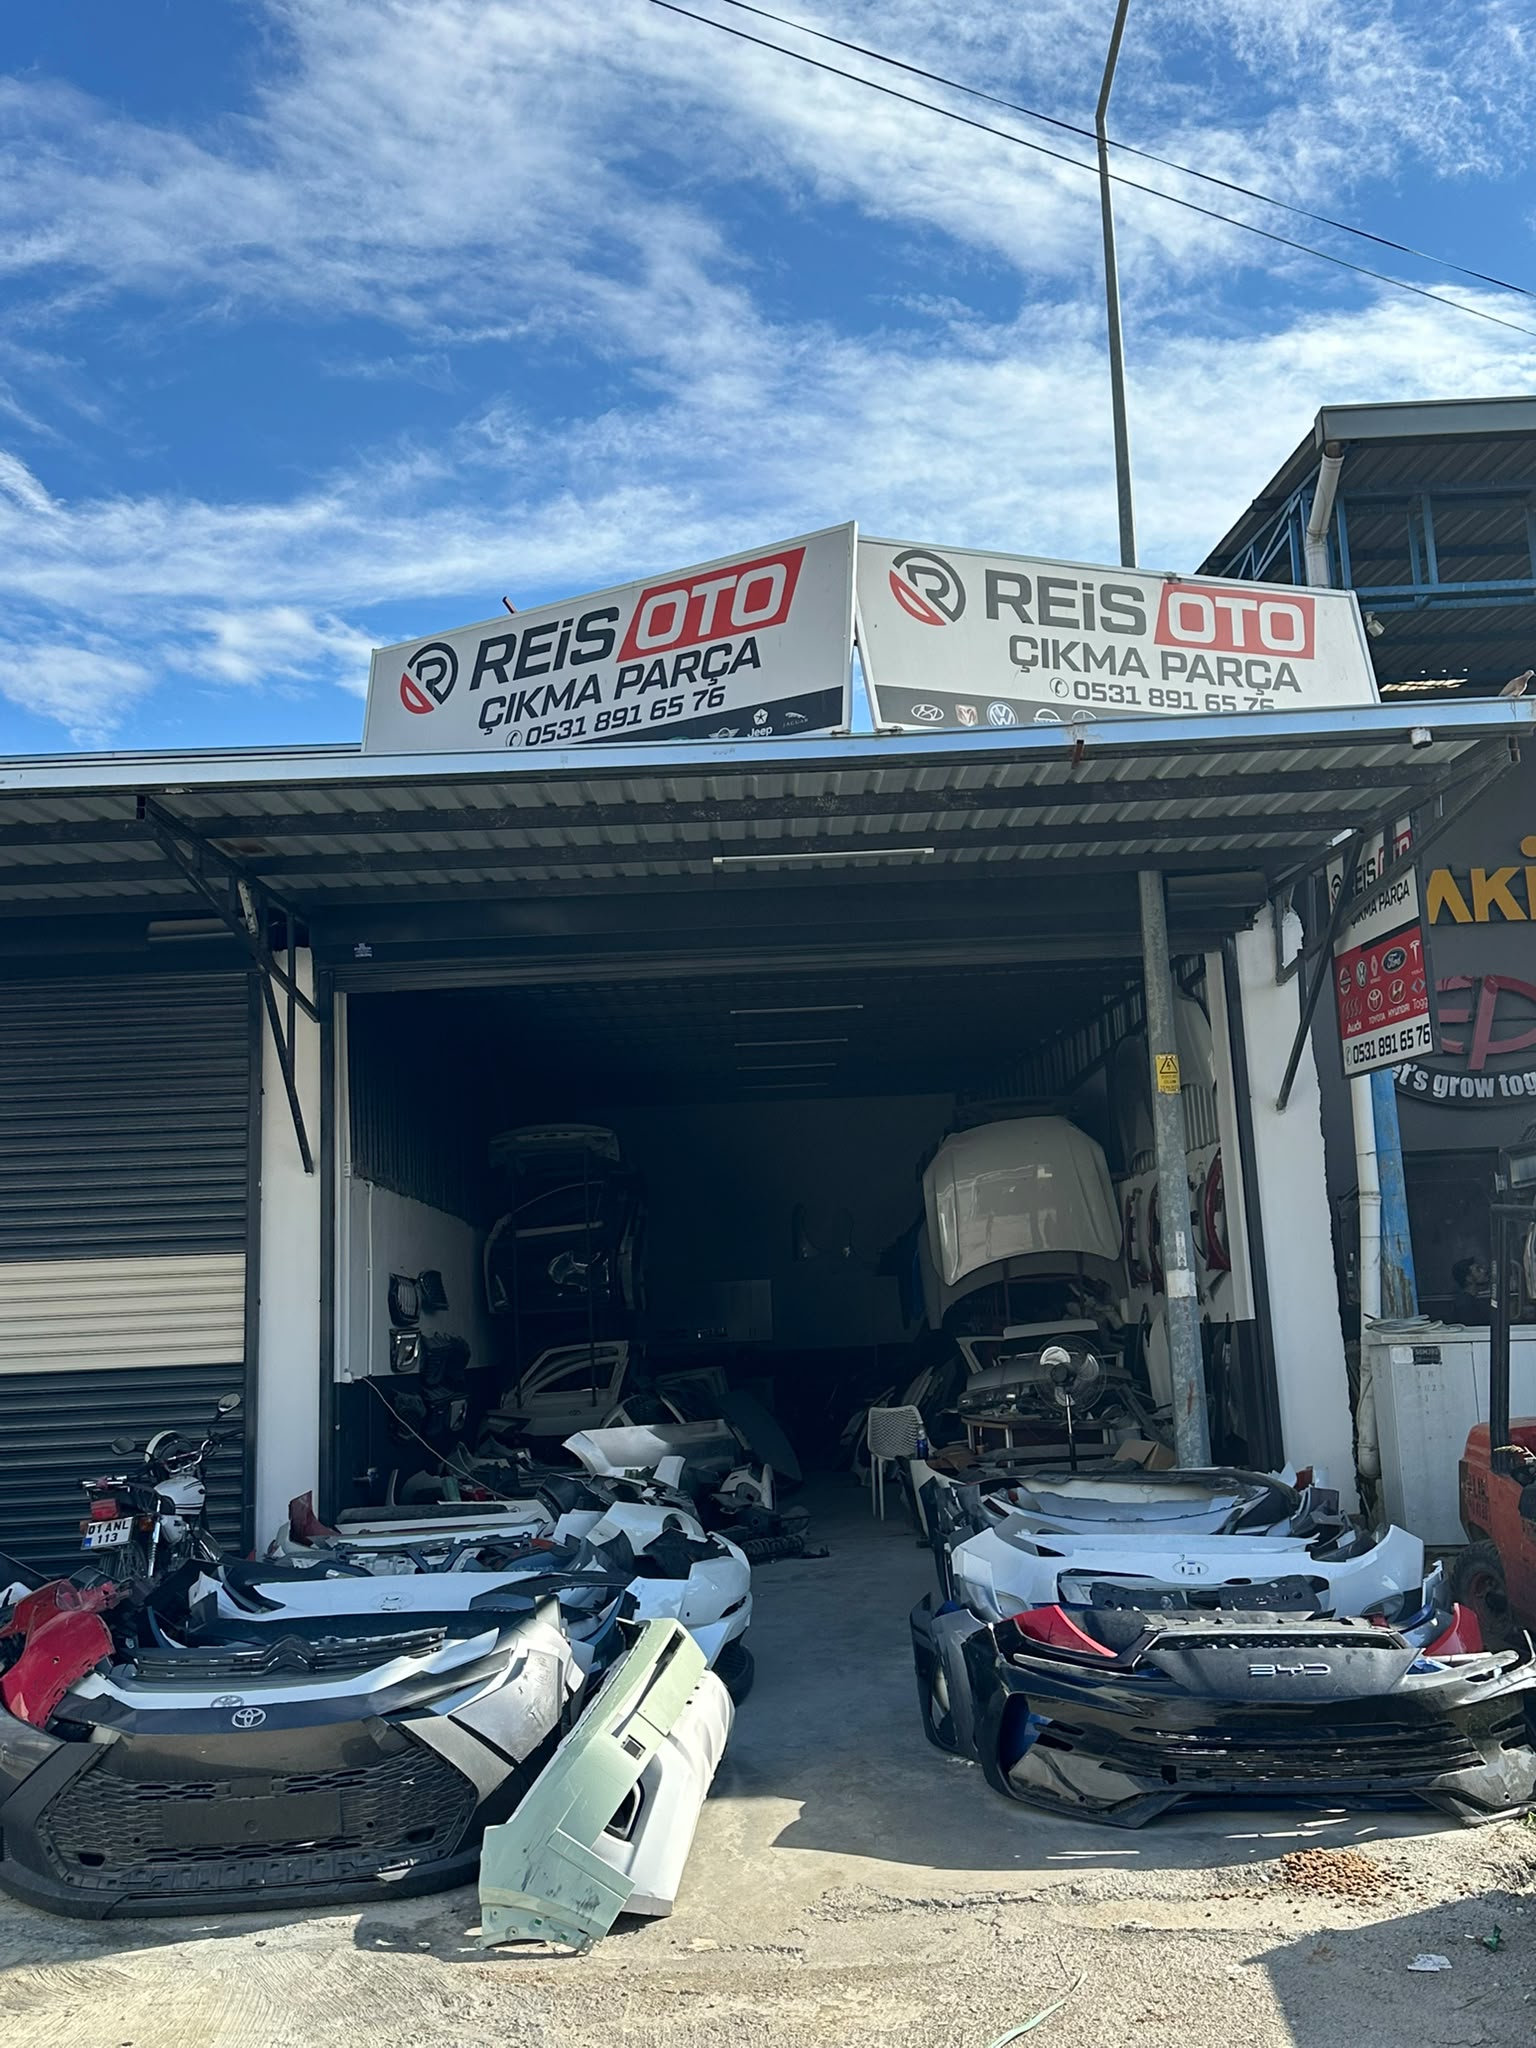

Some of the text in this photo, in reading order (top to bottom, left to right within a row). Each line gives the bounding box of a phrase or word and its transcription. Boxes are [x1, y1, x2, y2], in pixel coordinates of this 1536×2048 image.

[469, 563, 787, 691] REiS OTO
[984, 568, 1305, 653] REiS OTO
[1009, 635, 1302, 695] ÇIKMA PARÇA
[478, 636, 761, 736] ÇIKMA PARÇA
[1073, 680, 1142, 705] 0531
[1149, 689, 1199, 711] 891
[1205, 694, 1237, 712] 65
[525, 685, 726, 747] 0531 891 65 76
[747, 726, 773, 737] Jeep
[782, 718, 809, 729] JAGUAR
[1354, 857, 1377, 896] EiS
[1379, 879, 1410, 911] PARÇA
[1347, 1020, 1362, 1034] Audi
[1353, 1023, 1431, 1064] 0531 891 65 76
[1392, 1063, 1429, 1091] et's
[1433, 1074, 1494, 1098] grow
[88, 1520, 129, 1535] 01 ANL
[97, 1532, 118, 1544] 113
[1250, 1663, 1331, 1677] BYD
